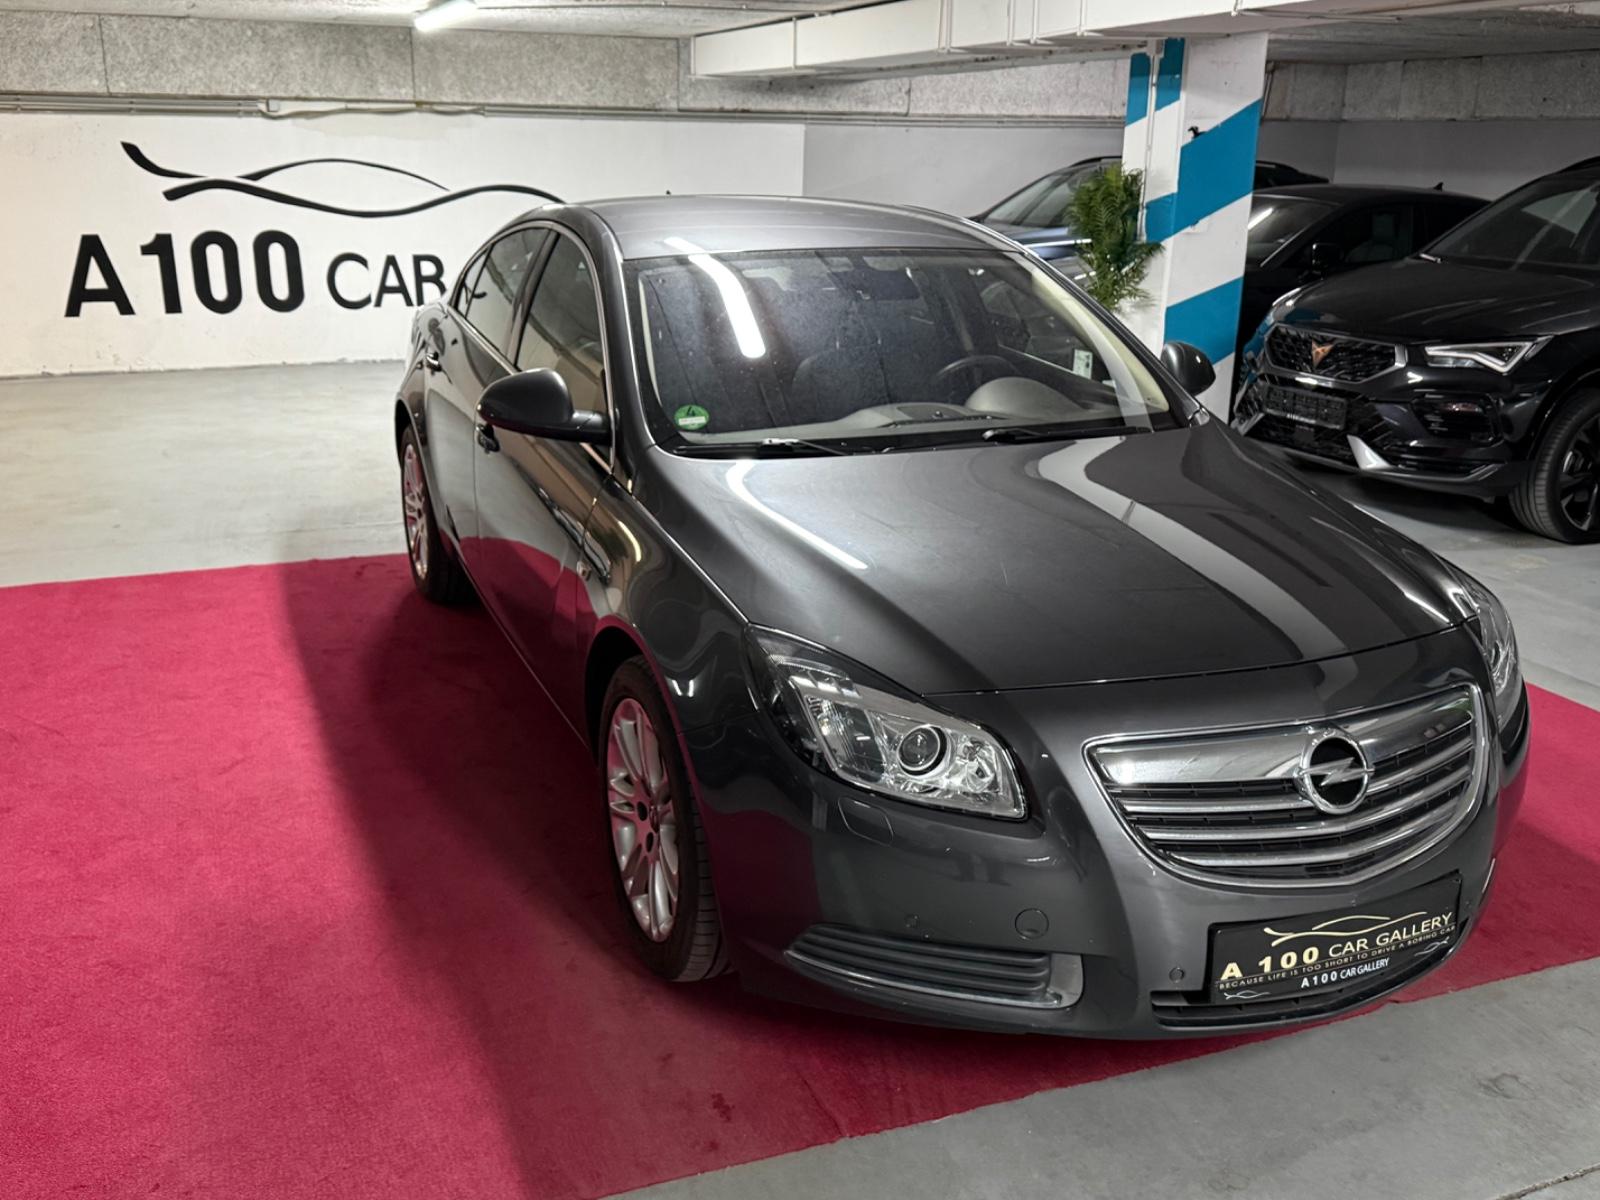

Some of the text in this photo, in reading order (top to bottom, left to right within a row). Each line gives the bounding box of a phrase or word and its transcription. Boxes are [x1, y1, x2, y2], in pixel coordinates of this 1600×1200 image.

[326, 252, 447, 310] CAR
[1219, 976, 1264, 990] BECAUSE
[1267, 972, 1286, 981] LIFE
[1302, 964, 1322, 973] TOO
[1324, 956, 1353, 968] SHORT
[1357, 952, 1368, 960] TO
[1371, 945, 1395, 957] DRIVE
[1407, 931, 1437, 946] BORING
[1439, 925, 1455, 935] CAR
[1328, 938, 1369, 958] CAR
[1376, 911, 1453, 946] GALLERY
[1340, 967, 1357, 979] CAR
[1356, 957, 1390, 975] GALLERY
